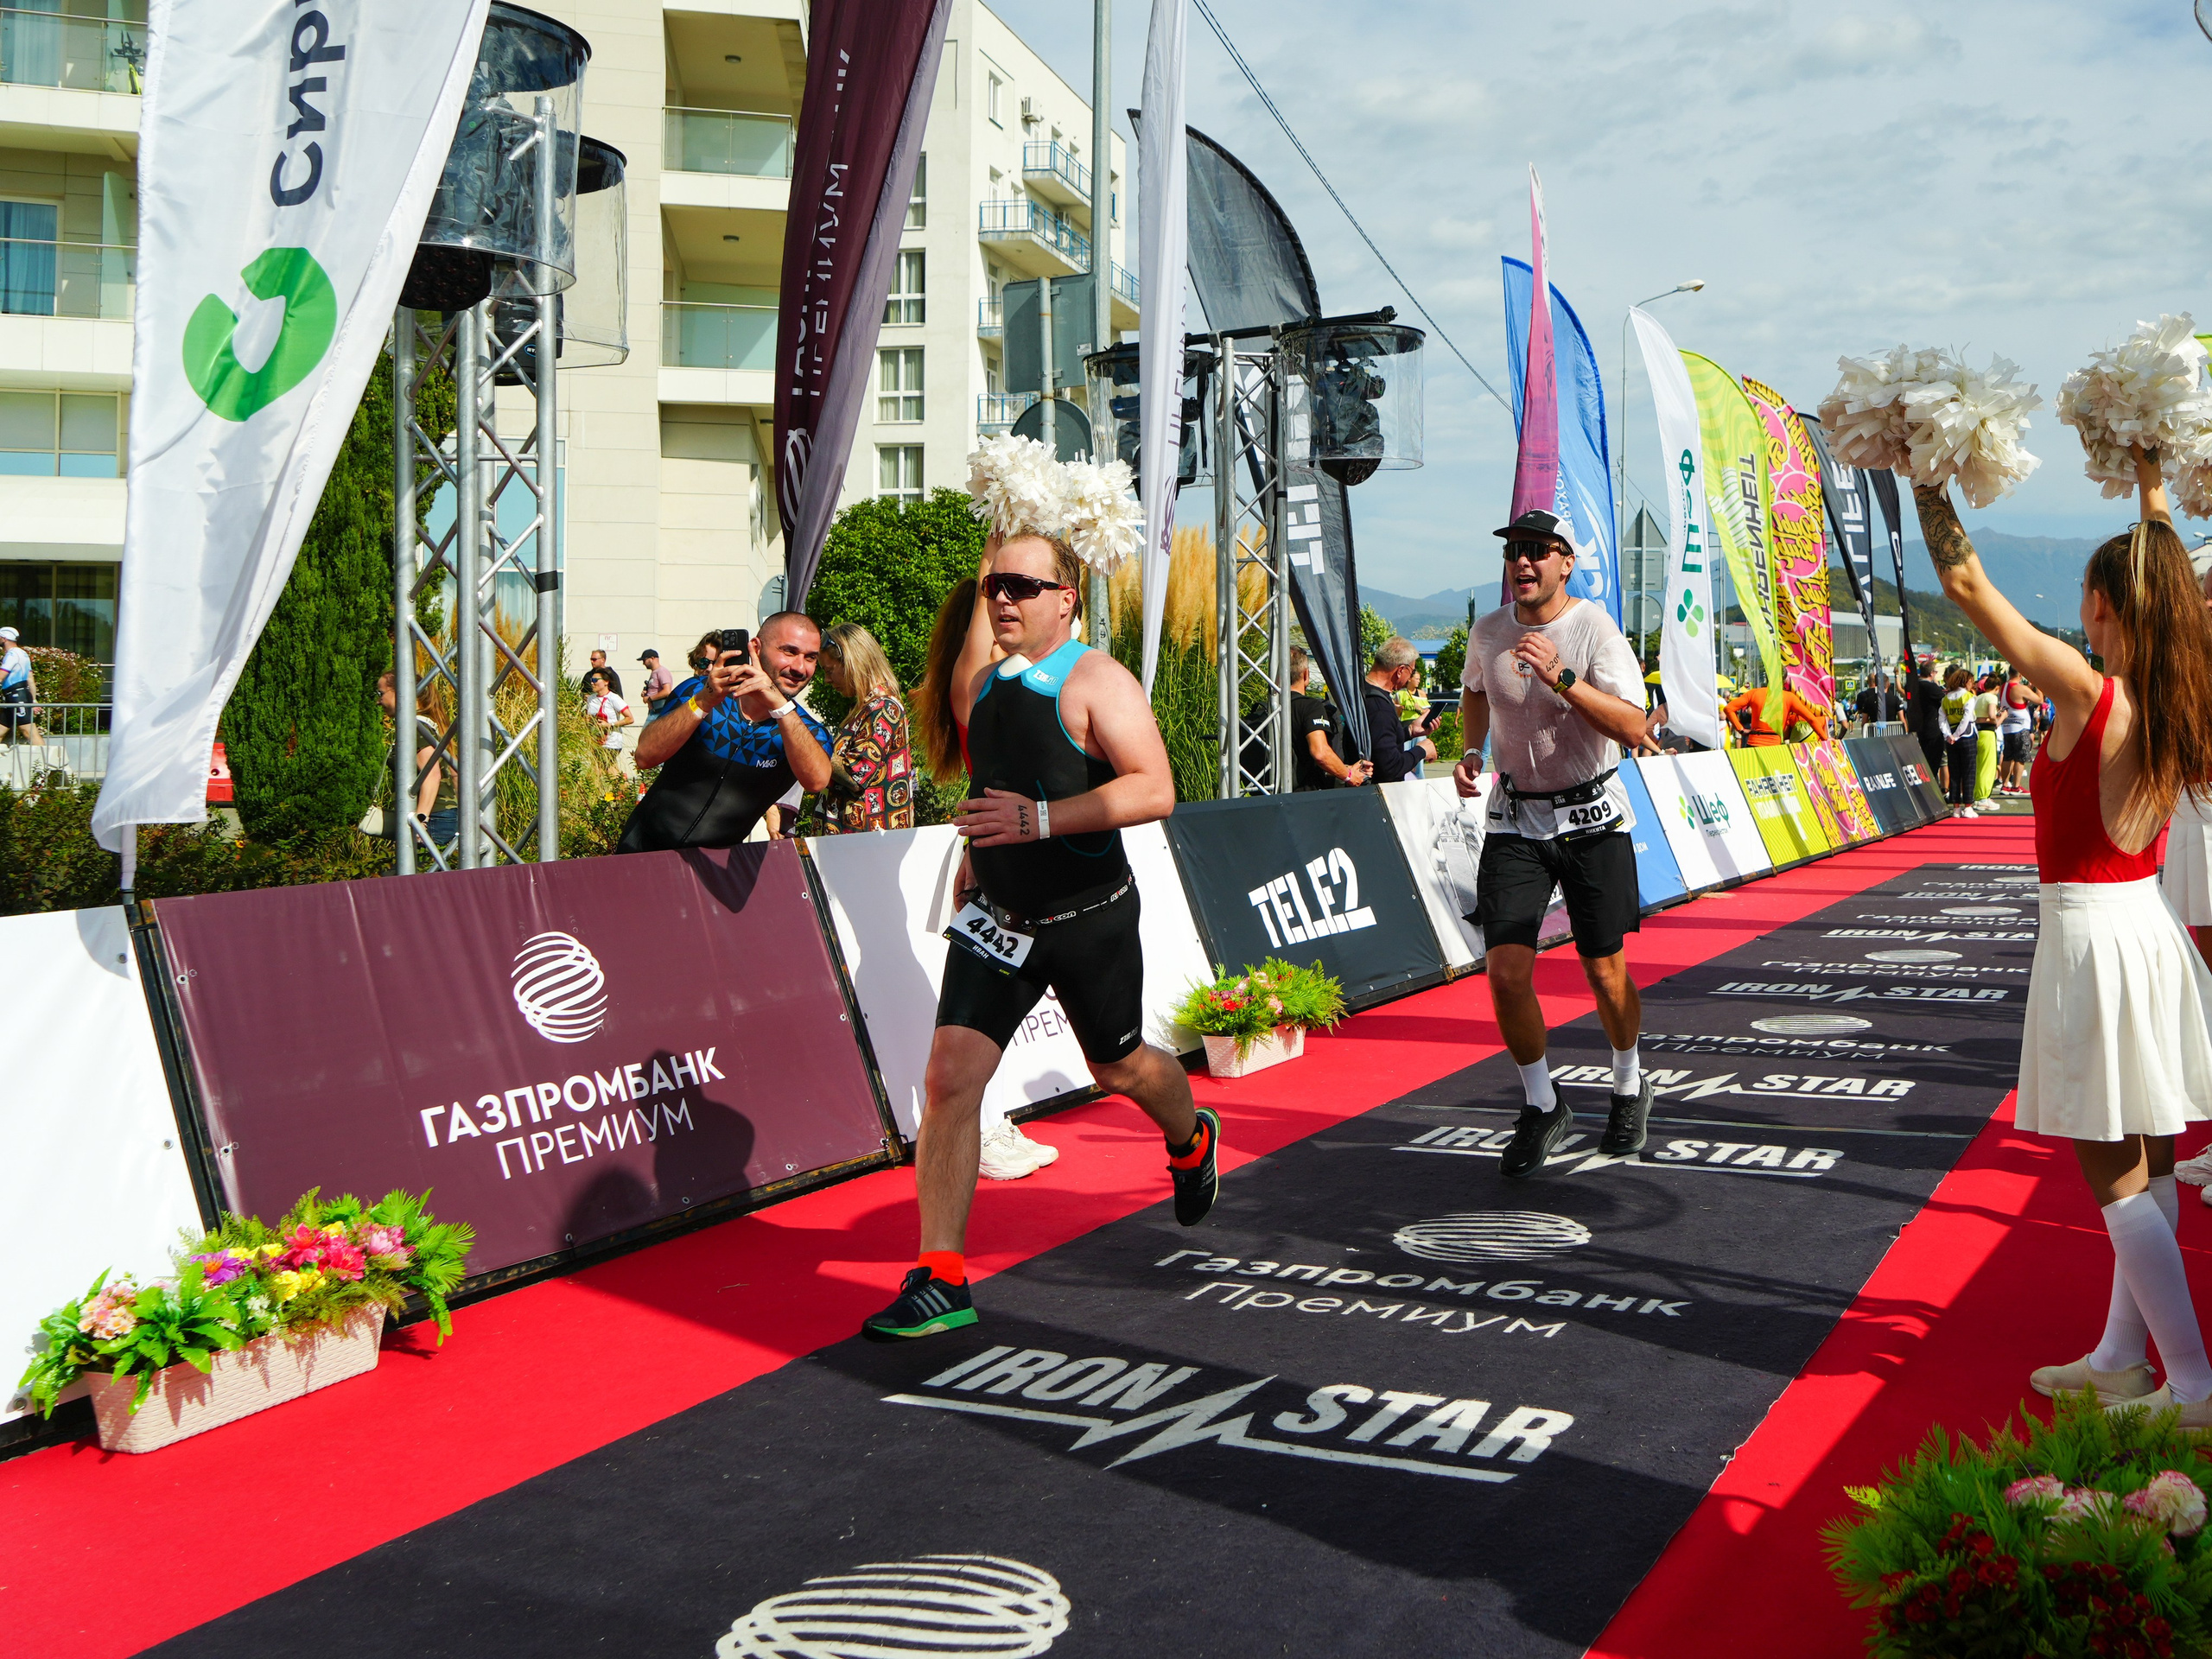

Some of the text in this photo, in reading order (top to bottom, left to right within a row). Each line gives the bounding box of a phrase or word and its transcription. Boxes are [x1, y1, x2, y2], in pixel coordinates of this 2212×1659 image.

[270, 0, 346, 207] Сир
[1017, 804, 1030, 836] 4442
[1568, 800, 1611, 826] 4209
[1248, 847, 1378, 949] TELE2
[966, 916, 1020, 959] 4442
[972, 944, 990, 960] ИВАН
[1825, 928, 2037, 940] IRON STA
[1761, 960, 2032, 975] Газпромбанк
[1715, 982, 2010, 1000] IRON STAR
[1650, 1042, 1886, 1060] Премиум
[421, 1046, 726, 1148] ГАЗПРОМБАНК
[1548, 1065, 1916, 1097] IRN STAR
[495, 1097, 695, 1179] ПРЕМИУМ
[1408, 1125, 1846, 1170] IRO STAR
[1154, 1249, 1693, 1318] Газпромбанк
[1185, 1281, 1570, 1338] Премиум
[923, 1345, 1574, 1465] IRON STAR
